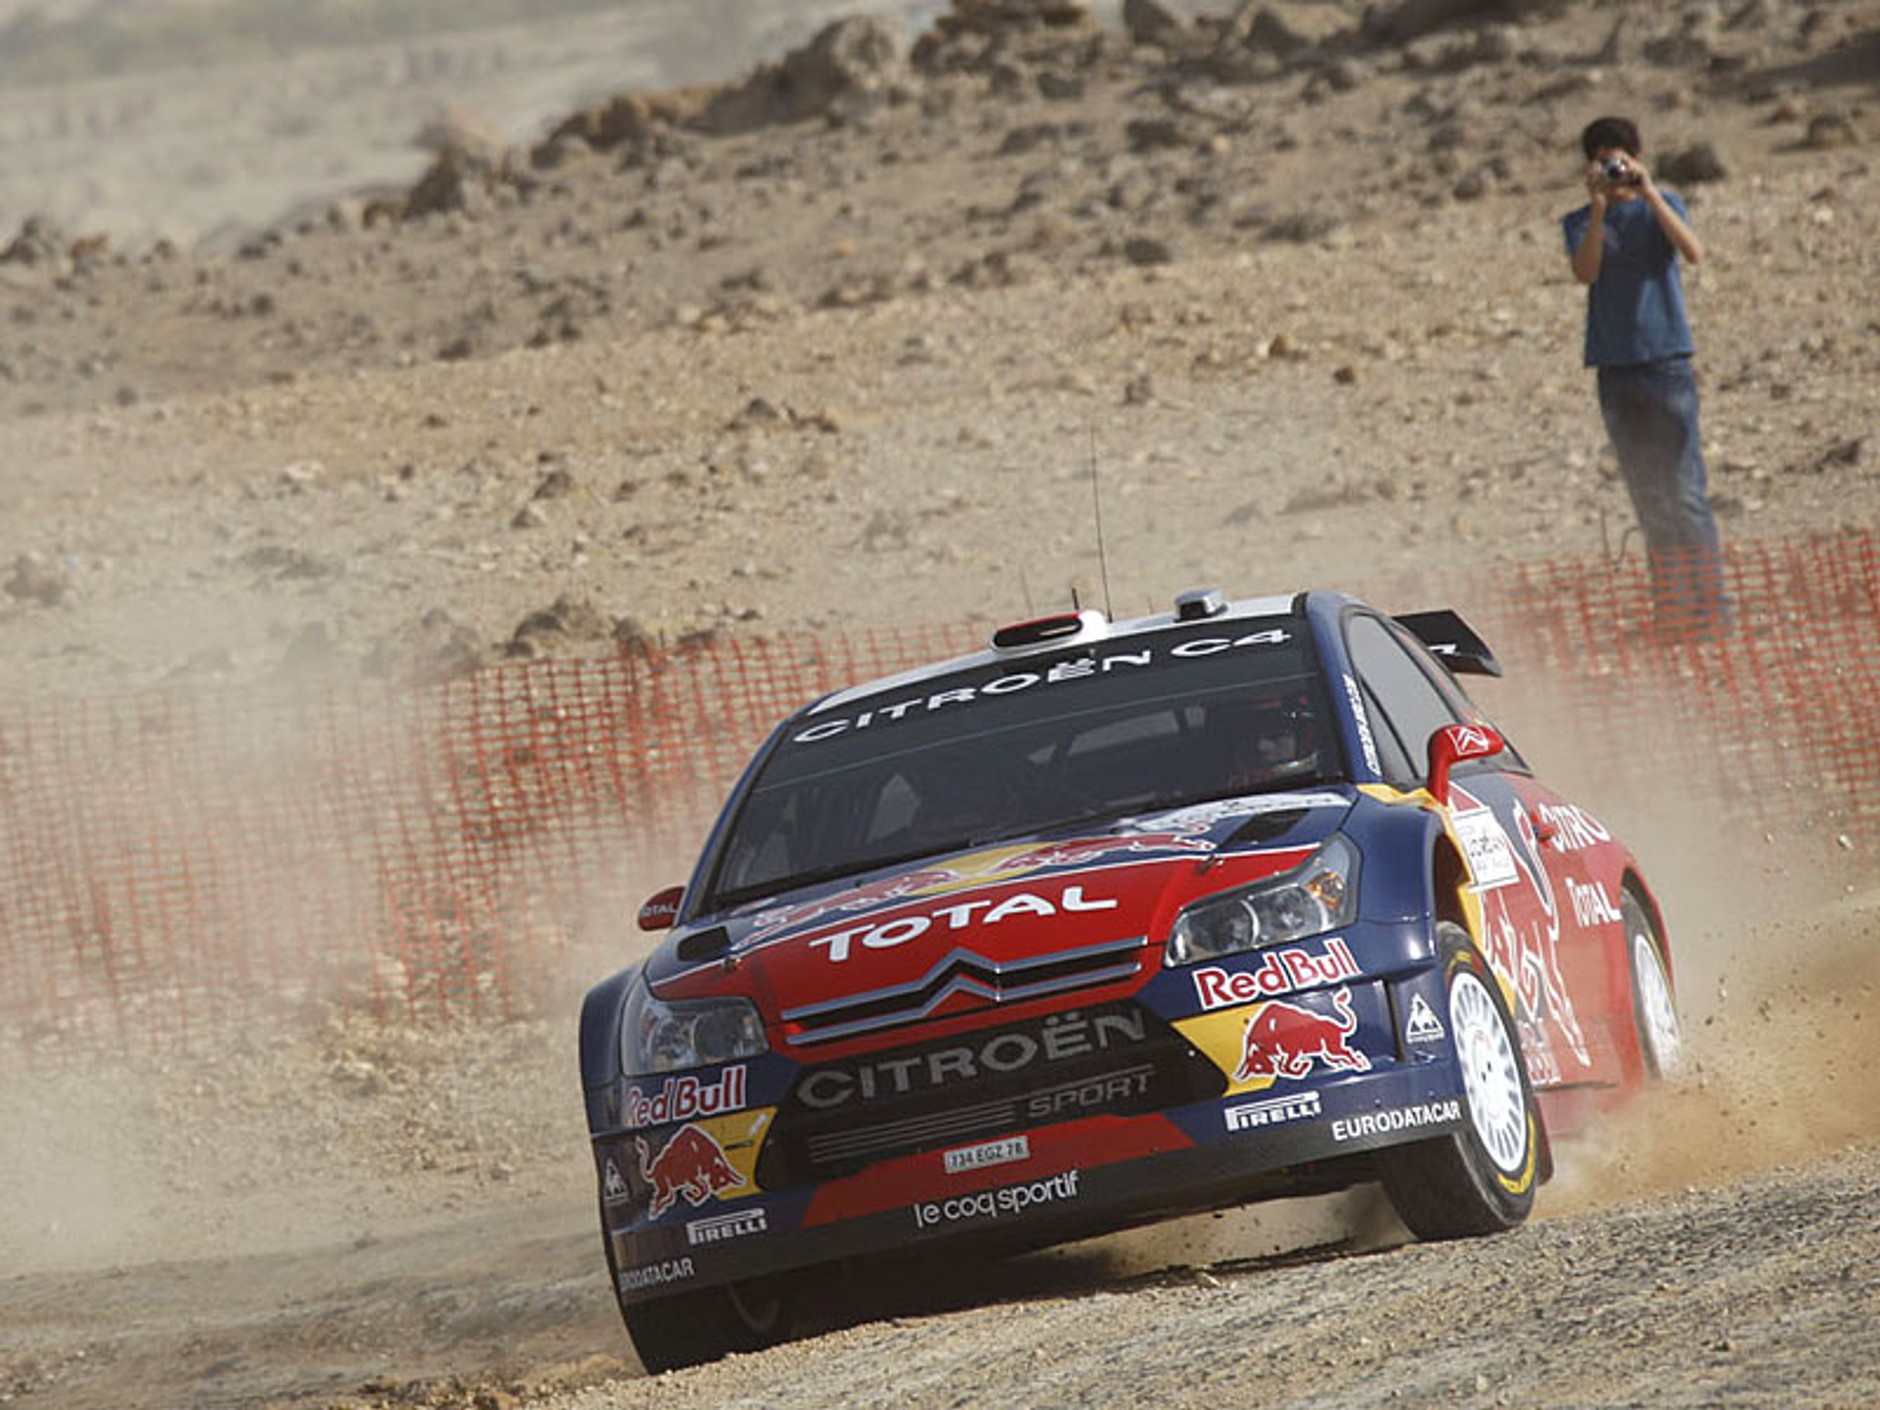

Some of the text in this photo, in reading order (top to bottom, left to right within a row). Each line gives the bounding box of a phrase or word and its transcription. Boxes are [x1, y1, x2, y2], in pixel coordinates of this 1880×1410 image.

[1171, 629, 1292, 657] C4
[641, 903, 678, 917] OTAL
[809, 886, 1118, 962] TOTAL
[1564, 876, 1623, 928] TOTAL
[1194, 939, 1361, 1009] Red Bull
[797, 1009, 1146, 1108] CITROËN
[674, 1066, 746, 1119] Bull
[1028, 1072, 1153, 1118] SPORT
[1225, 1091, 1321, 1131] PIRELLI
[1332, 1101, 1461, 1141] EURODATACAR
[914, 1169, 1079, 1228] le coq sportif
[686, 1208, 767, 1245] PIRELLI
